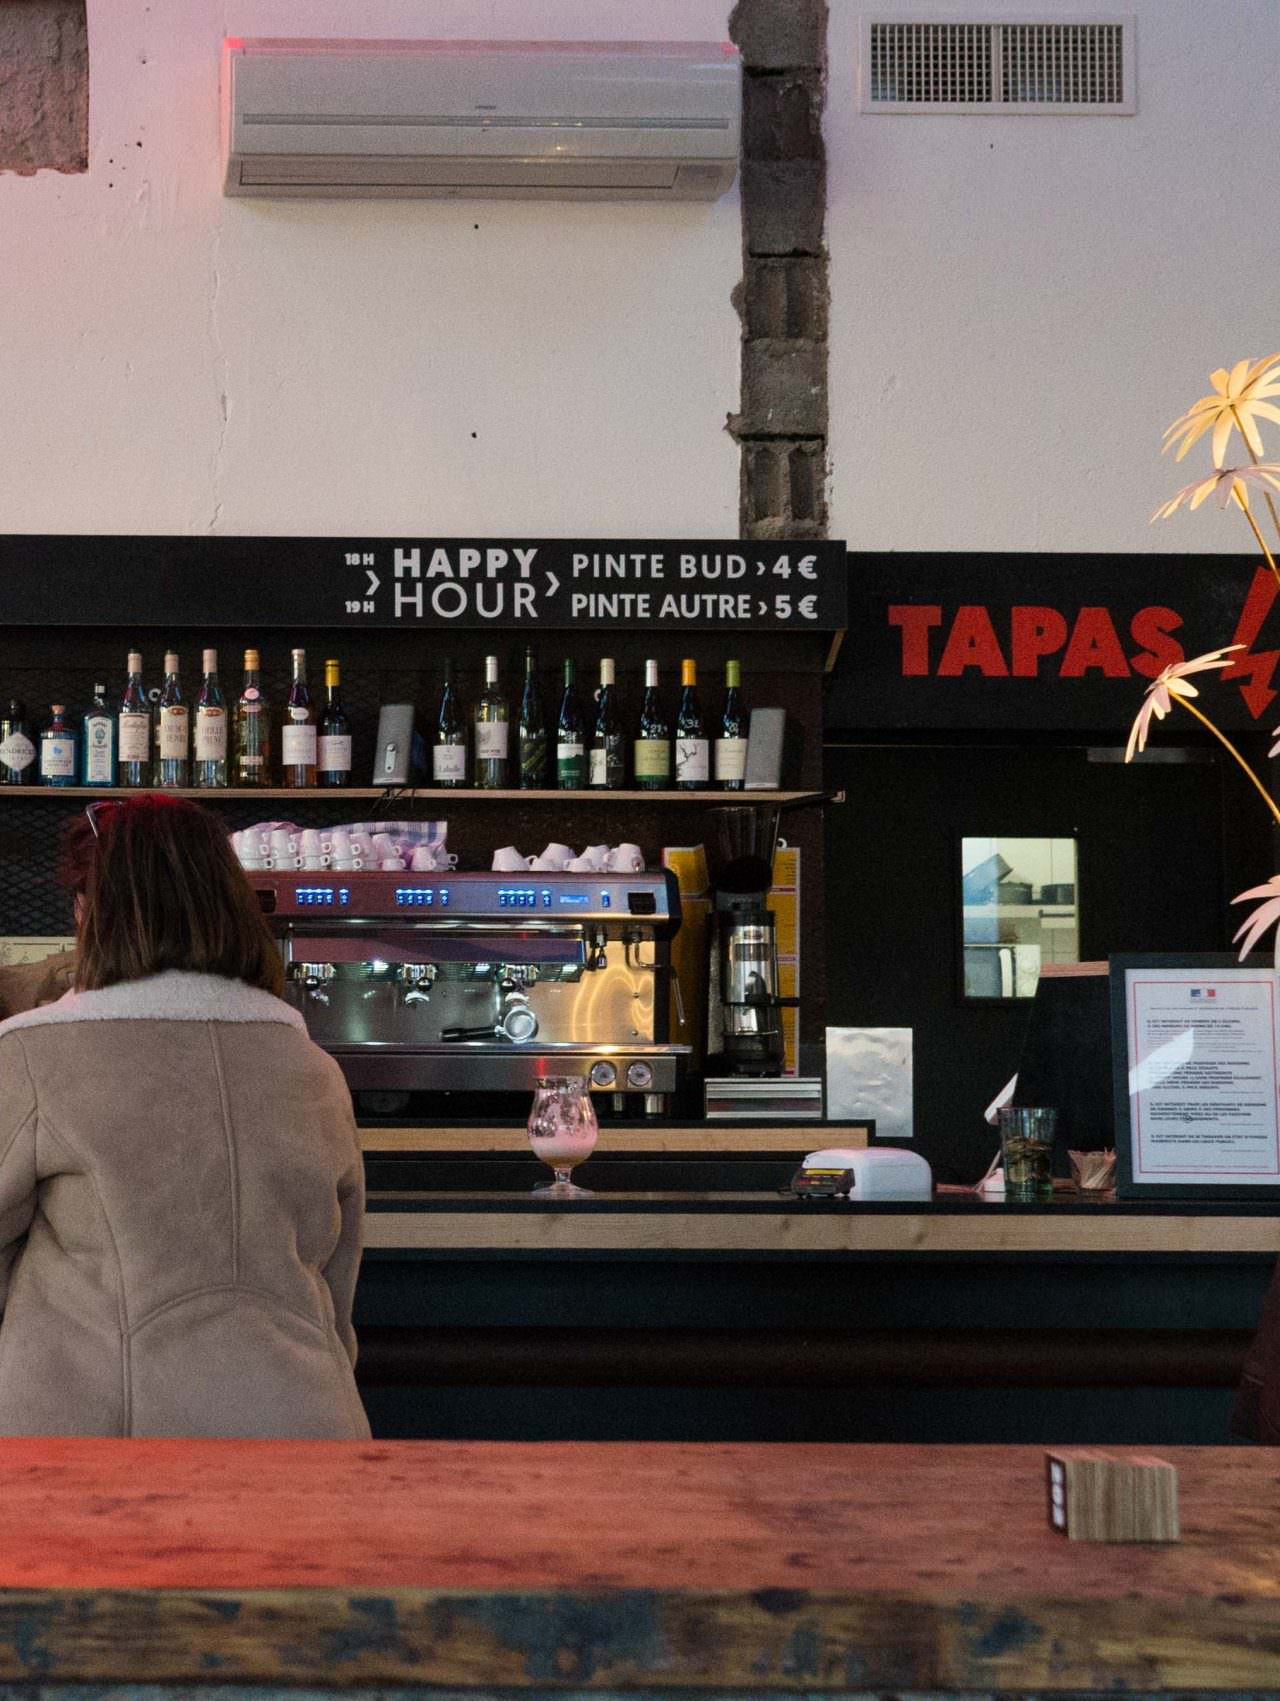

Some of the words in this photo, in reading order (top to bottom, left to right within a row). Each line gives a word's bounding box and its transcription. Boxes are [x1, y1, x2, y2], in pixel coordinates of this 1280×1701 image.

[393, 547, 539, 578] HAPPY
[572, 553, 665, 579] PINTE
[679, 554, 748, 580] BUD
[394, 581, 539, 619] HOUR
[571, 593, 651, 618] PINTE
[658, 594, 752, 619] AUTRE
[887, 604, 1185, 678] TAPAS
